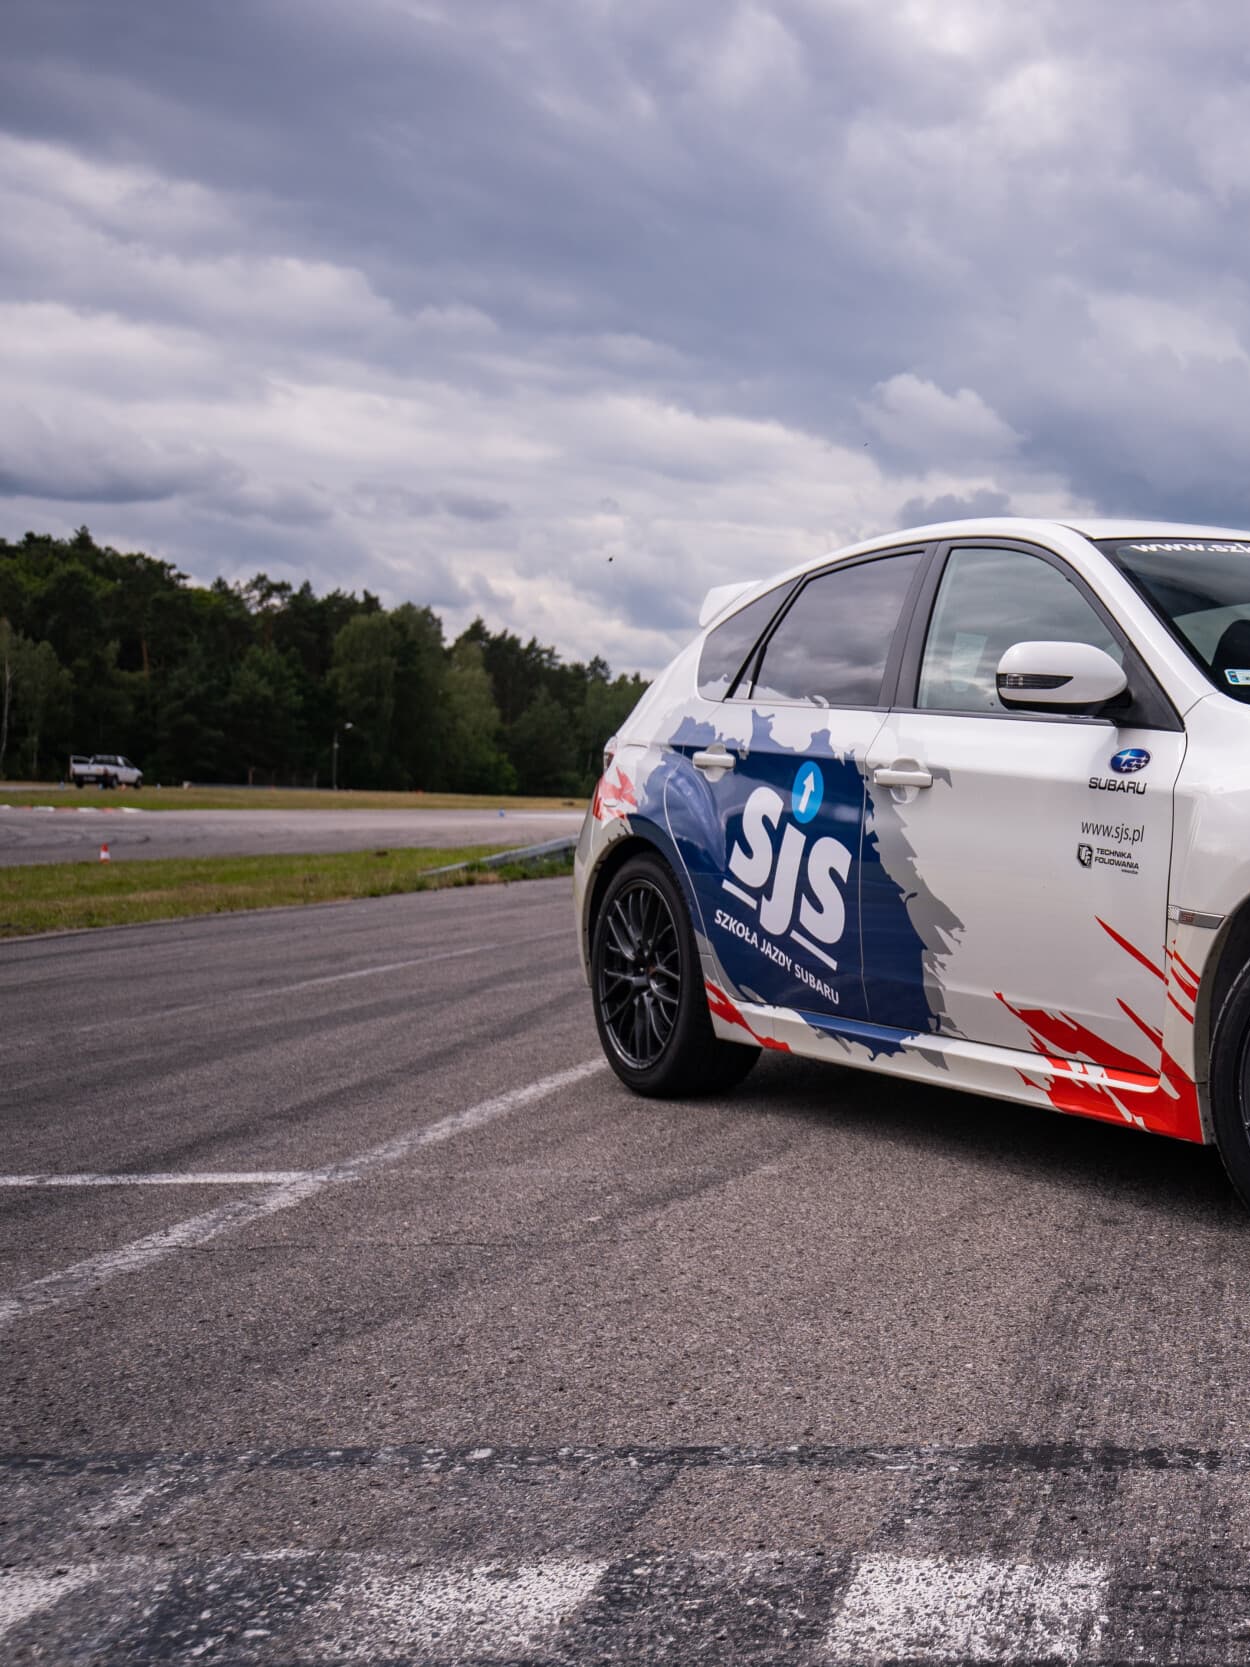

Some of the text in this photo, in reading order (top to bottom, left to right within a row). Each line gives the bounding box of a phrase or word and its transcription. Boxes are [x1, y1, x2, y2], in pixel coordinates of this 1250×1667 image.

[1088, 777, 1147, 795] SUBARU
[1081, 821, 1145, 845] www.sjs.pl
[1096, 847, 1132, 860] TECHNIKA
[1094, 856, 1139, 870] FOLIOWANIA
[714, 909, 839, 1005] SZKOŁA JAZDY SUBARU
